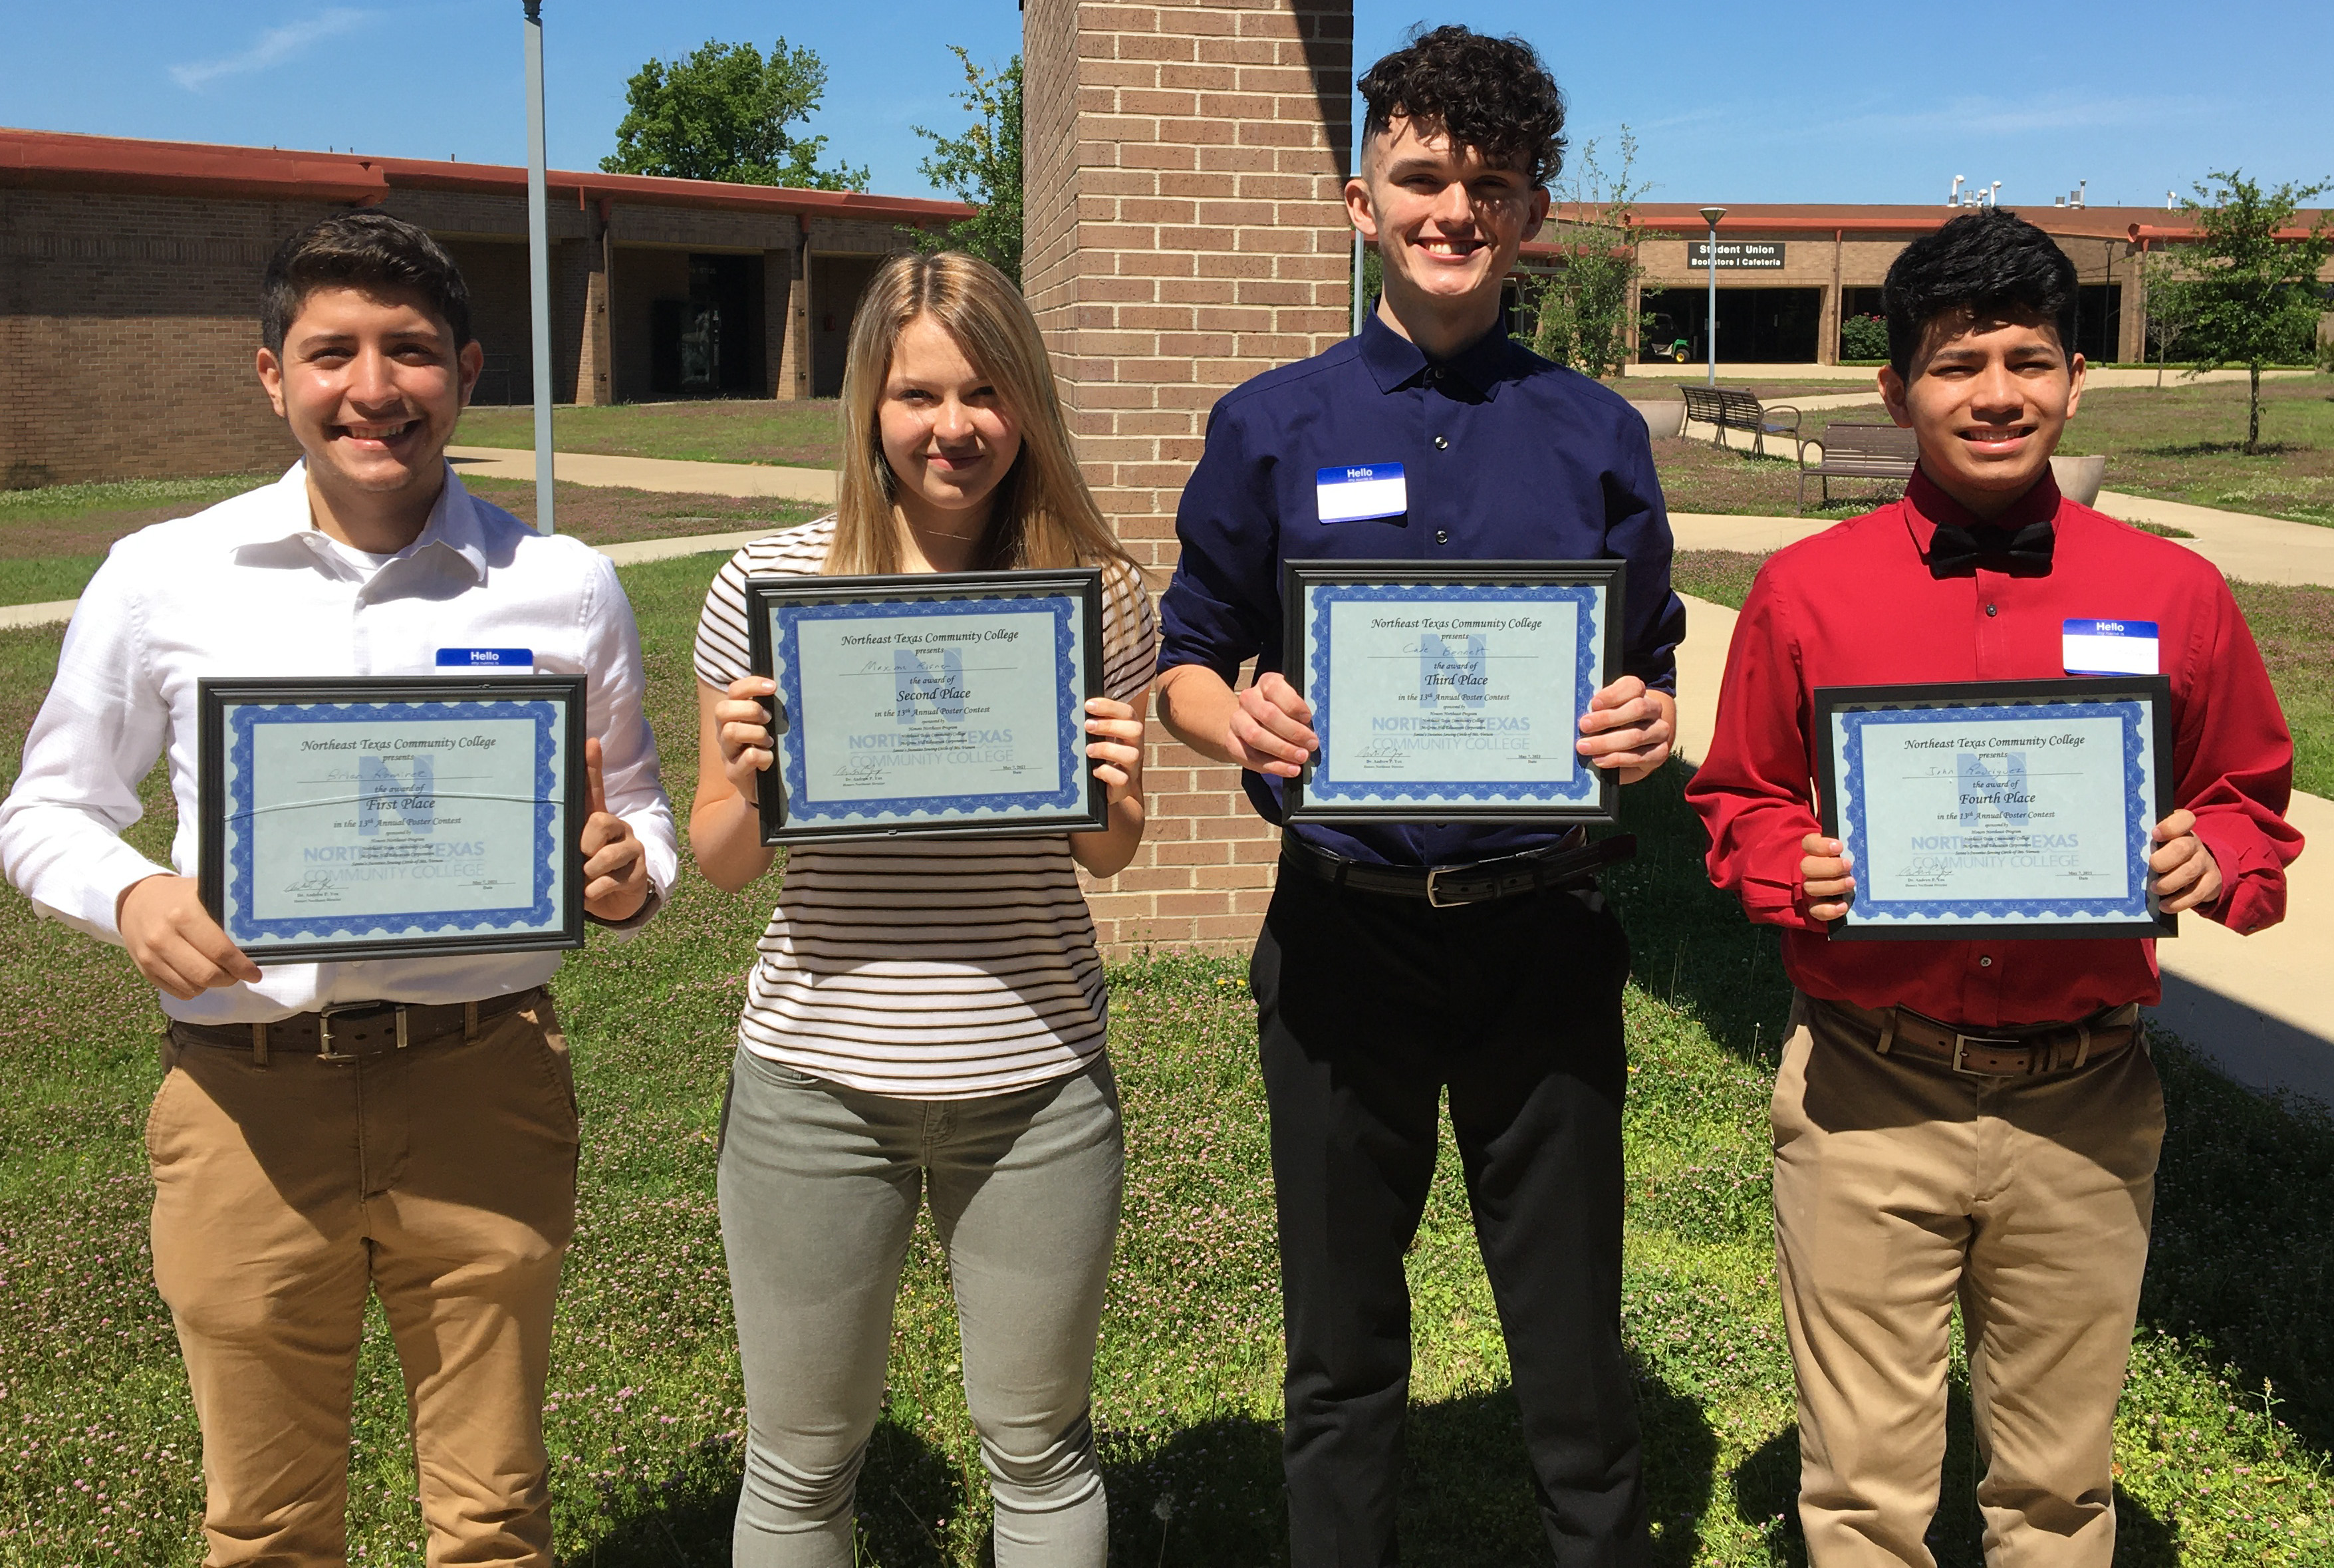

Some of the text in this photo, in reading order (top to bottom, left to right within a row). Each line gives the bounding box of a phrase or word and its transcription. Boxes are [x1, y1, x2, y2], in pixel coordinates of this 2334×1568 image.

[1746, 245, 1774, 254] Union
[1347, 468, 1372, 478] Hello
[1371, 617, 1542, 630] Northeast Texas Community College
[2096, 622, 2124, 631] Hello
[841, 629, 1019, 646] Northeast Texas Community College
[471, 652, 499, 660] Hello
[915, 647, 944, 656] presents
[1470, 662, 1479, 671] of
[947, 675, 956, 685] of
[1424, 674, 1488, 686] Third Place
[896, 687, 971, 702] Second Place
[911, 708, 938, 717] Annual
[301, 735, 496, 751] Northeast Texas Community College
[1372, 737, 1530, 750] COMMUNITY COLLEGE
[1904, 734, 2085, 749] Northeast Texas Community College
[382, 754, 414, 763] presents
[850, 749, 1013, 768] COMMUNITY COLLEGE
[1978, 752, 2008, 761] presents
[415, 784, 426, 794] of
[2010, 780, 2019, 789] of
[1960, 791, 2035, 805] Fourth Place
[366, 796, 436, 811] First Place
[1974, 811, 2002, 821] Annual
[344, 819, 356, 828] the
[374, 819, 405, 827] Annual
[406, 818, 432, 827] Poster
[433, 817, 461, 825] Contest
[1913, 854, 2079, 869] COMMUNITY COLLEGE
[304, 864, 484, 884] COMMUNITY COLLEGE
